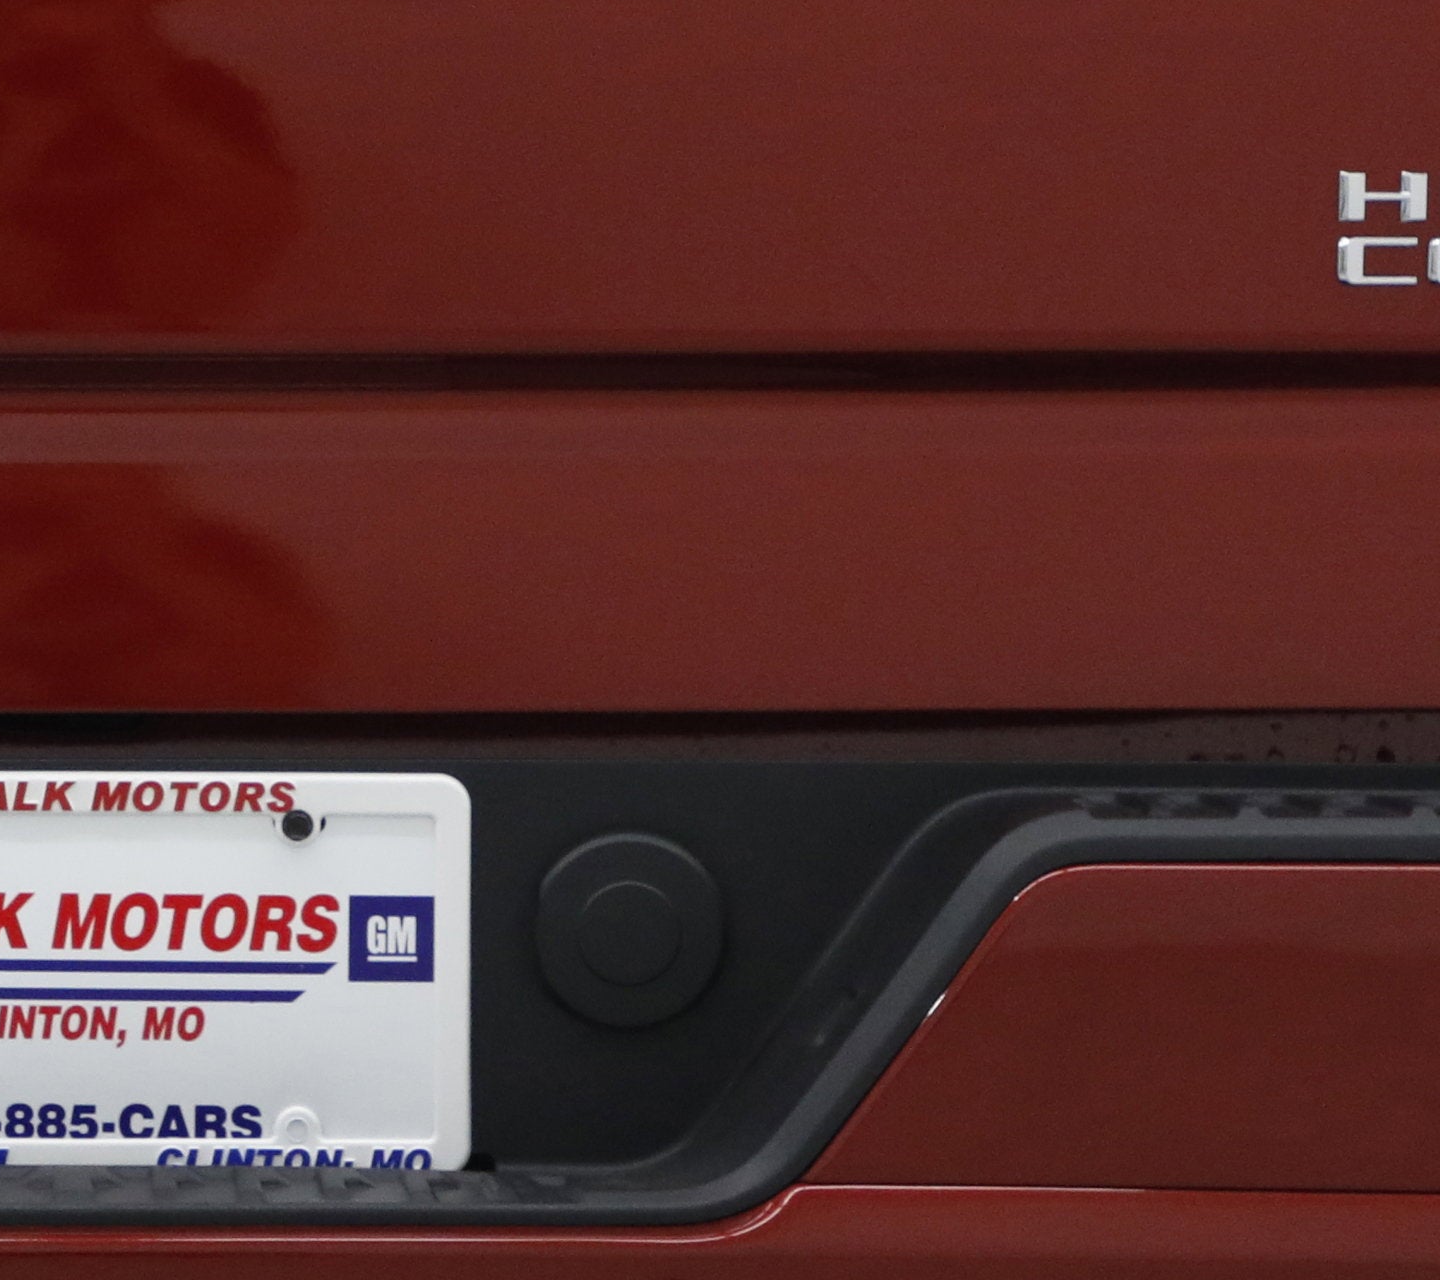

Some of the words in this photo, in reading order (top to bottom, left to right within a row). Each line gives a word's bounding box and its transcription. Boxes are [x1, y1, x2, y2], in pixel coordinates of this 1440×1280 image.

[93, 782, 296, 812] MOTORS
[53, 893, 339, 952] MOTORS
[366, 916, 416, 955] GM
[144, 1007, 204, 1040] MO
